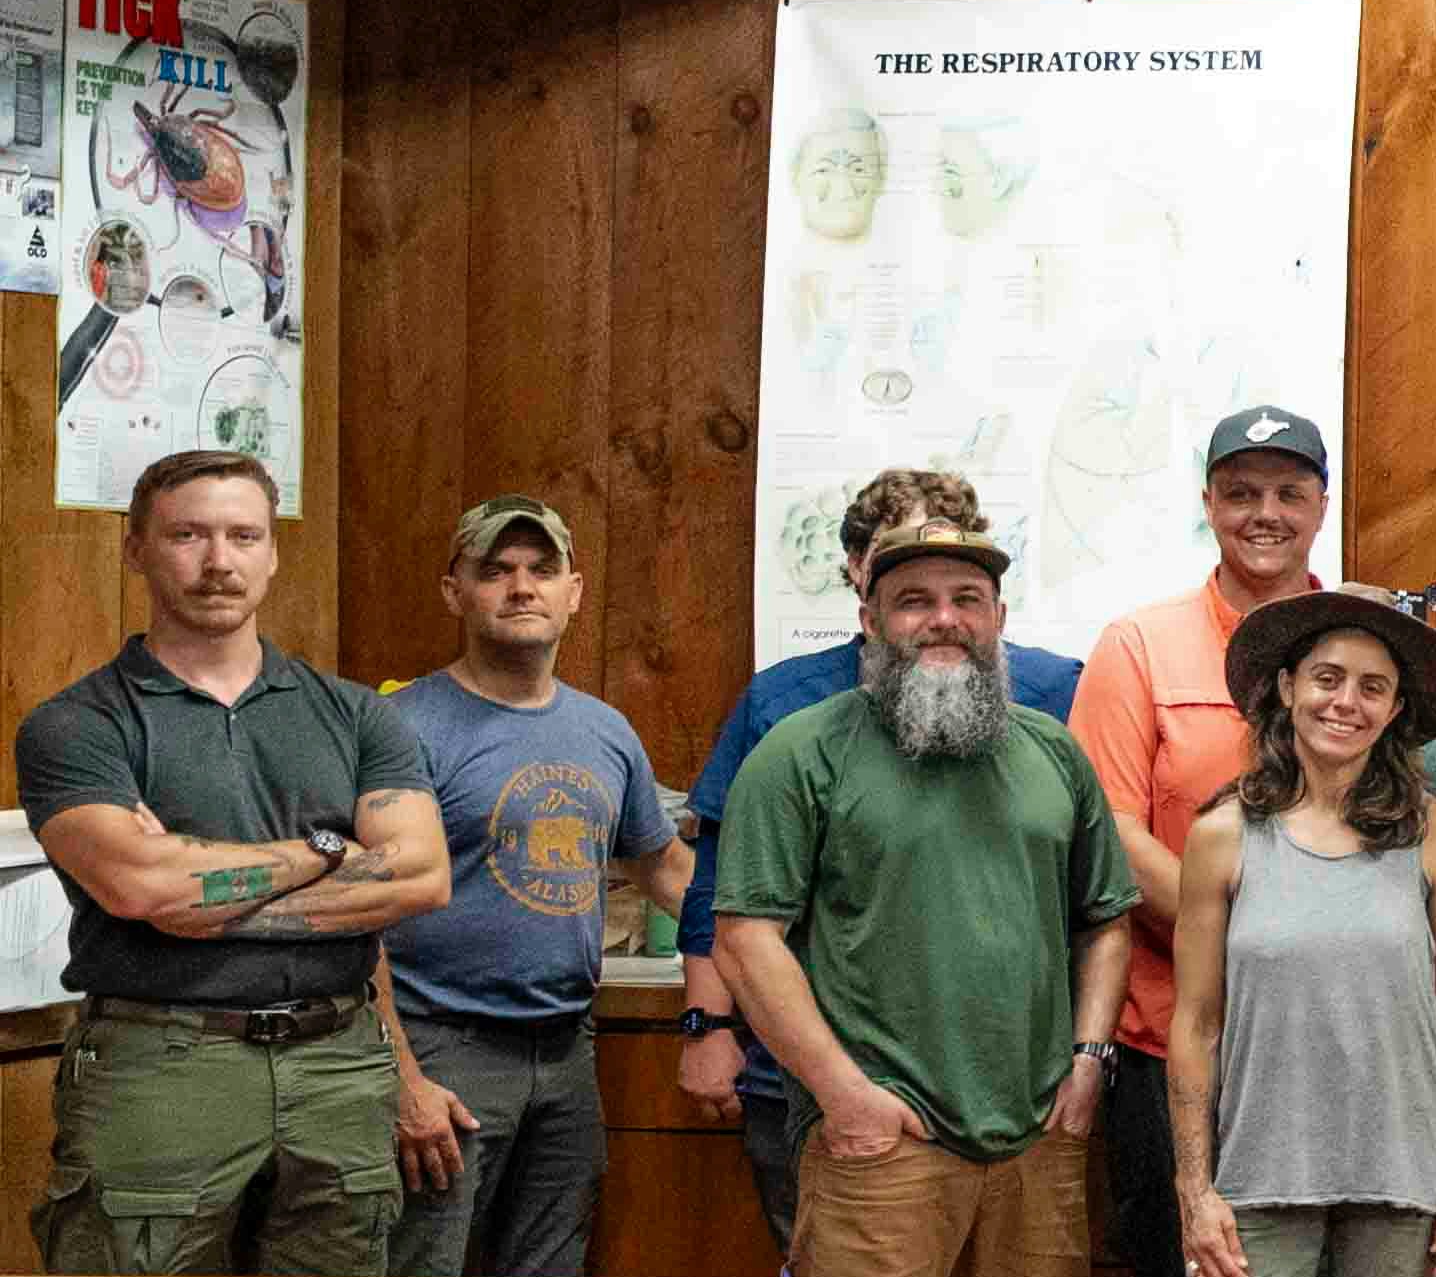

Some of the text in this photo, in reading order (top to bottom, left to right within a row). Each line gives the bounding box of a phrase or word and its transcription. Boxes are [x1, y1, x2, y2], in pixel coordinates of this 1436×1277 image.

[76, 59, 146, 86] PREVENTION
[159, 48, 232, 94] KILL
[874, 49, 1263, 74] THE RESPIRATORY SYSTEM
[76, 79, 113, 101] IS THE
[76, 99, 99, 117] KEY
[791, 627, 850, 641] A cigarette
